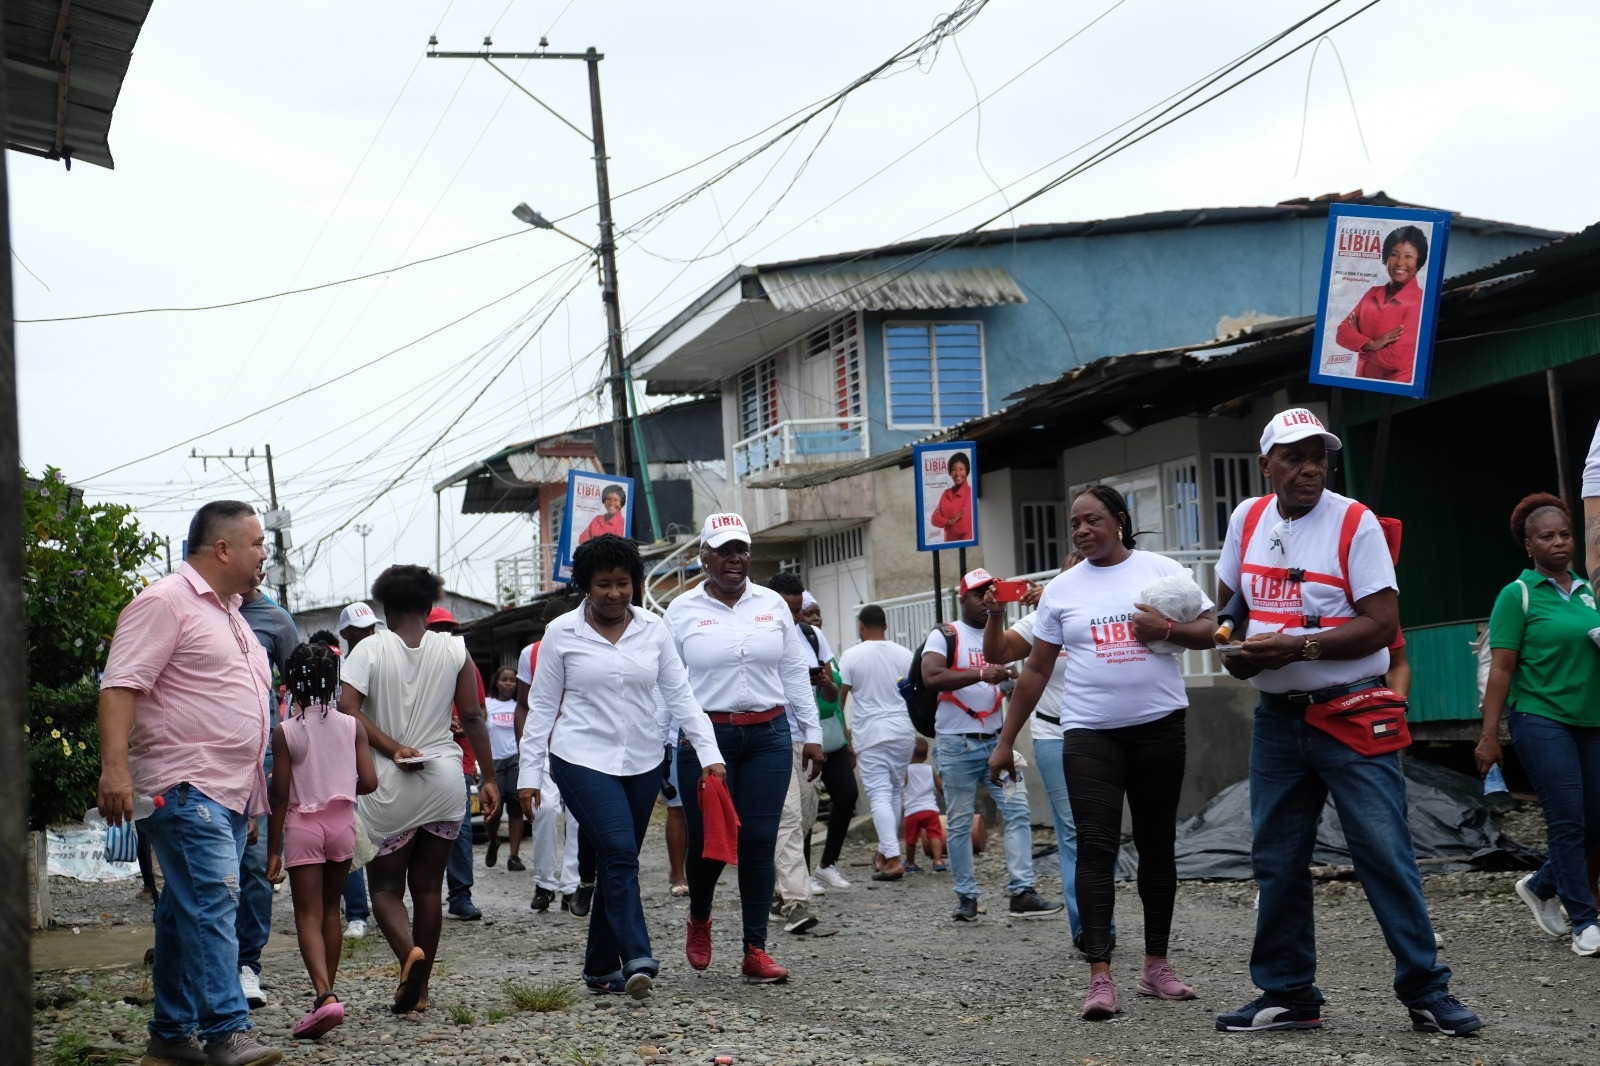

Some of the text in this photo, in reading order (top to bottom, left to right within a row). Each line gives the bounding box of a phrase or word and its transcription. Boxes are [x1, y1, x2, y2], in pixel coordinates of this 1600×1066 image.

[1341, 228, 1380, 236] ALCALDESA
[1339, 233, 1381, 253] LIBIA
[925, 461, 947, 471] LIBIA
[577, 485, 600, 497] LIBIA
[712, 517, 743, 529] LIBIA
[1251, 575, 1302, 599] LIBIA
[1090, 614, 1132, 626] ALCALDE
[1091, 621, 1135, 645] LIBI
[1097, 642, 1127, 650] MOSQUERA
[1341, 694, 1364, 706] TOMMY
